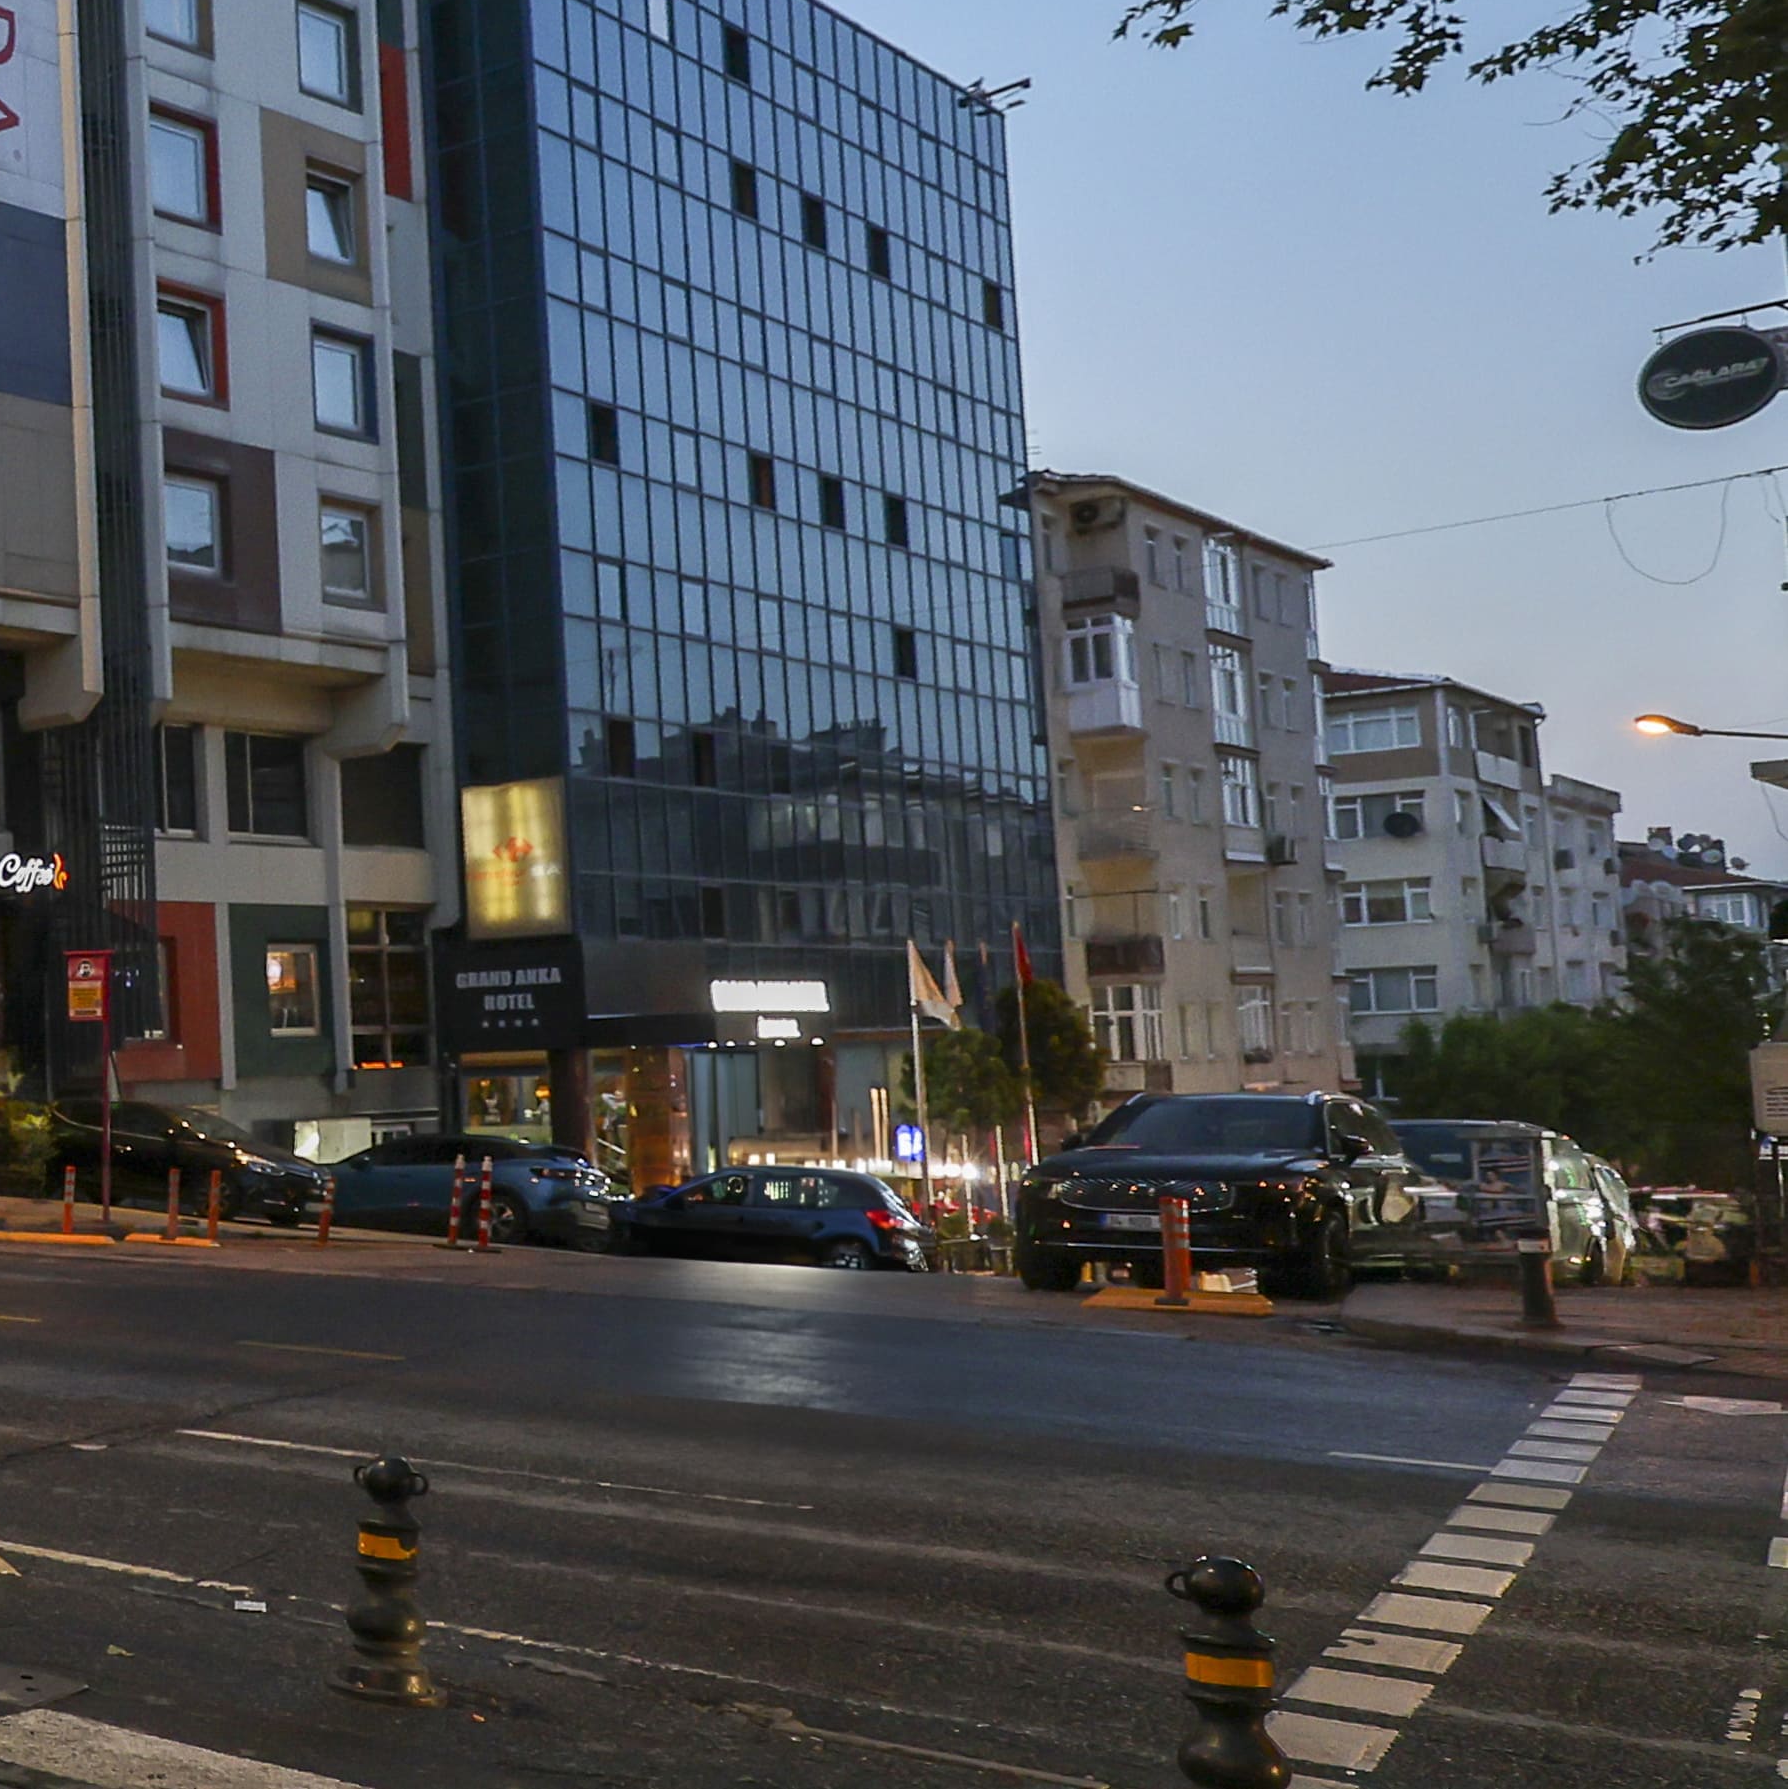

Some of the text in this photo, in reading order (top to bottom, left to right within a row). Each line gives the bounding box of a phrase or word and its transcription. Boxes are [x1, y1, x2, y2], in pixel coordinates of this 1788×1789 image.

[456, 967, 561, 989] GRAND ANKA
[484, 993, 535, 1011] HOTEL
